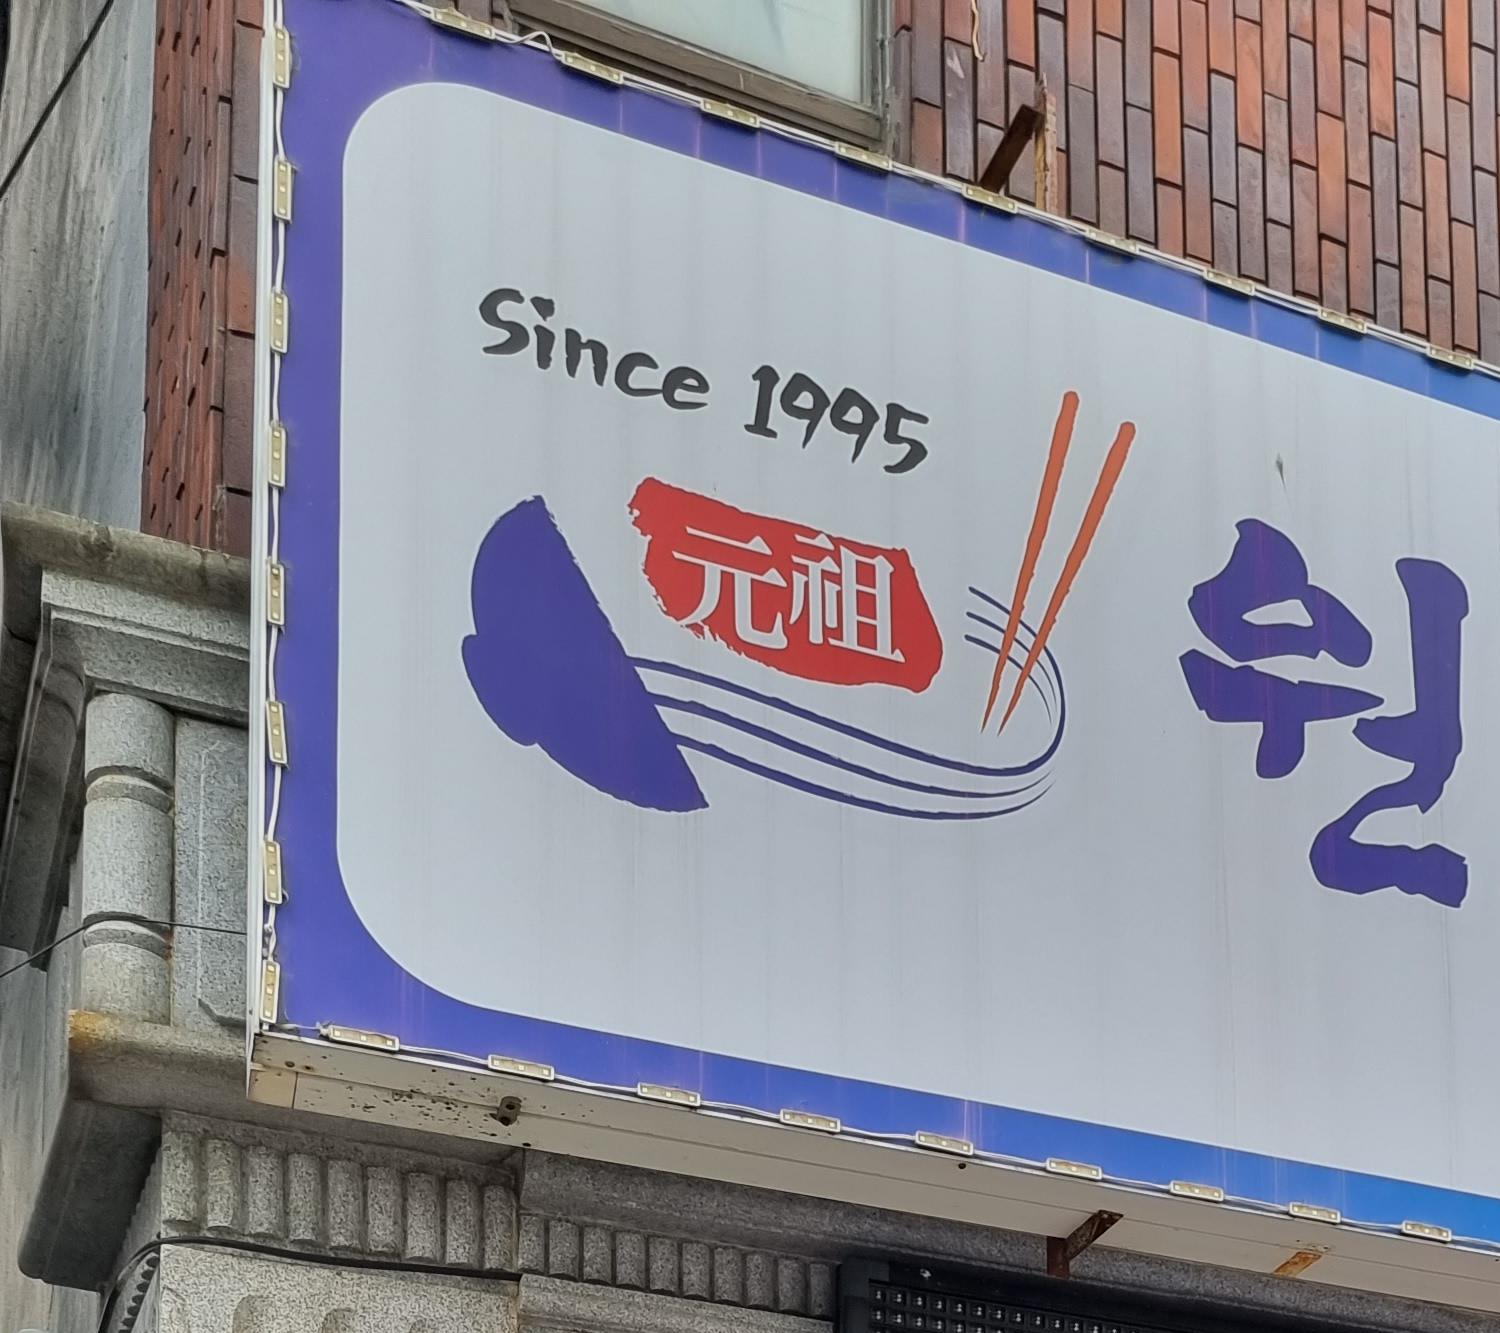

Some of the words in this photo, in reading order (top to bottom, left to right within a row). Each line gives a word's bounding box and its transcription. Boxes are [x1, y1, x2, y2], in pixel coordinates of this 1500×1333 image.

[479, 287, 710, 410] Since
[743, 364, 930, 474] 1995
[672, 525, 905, 663] 元祖
